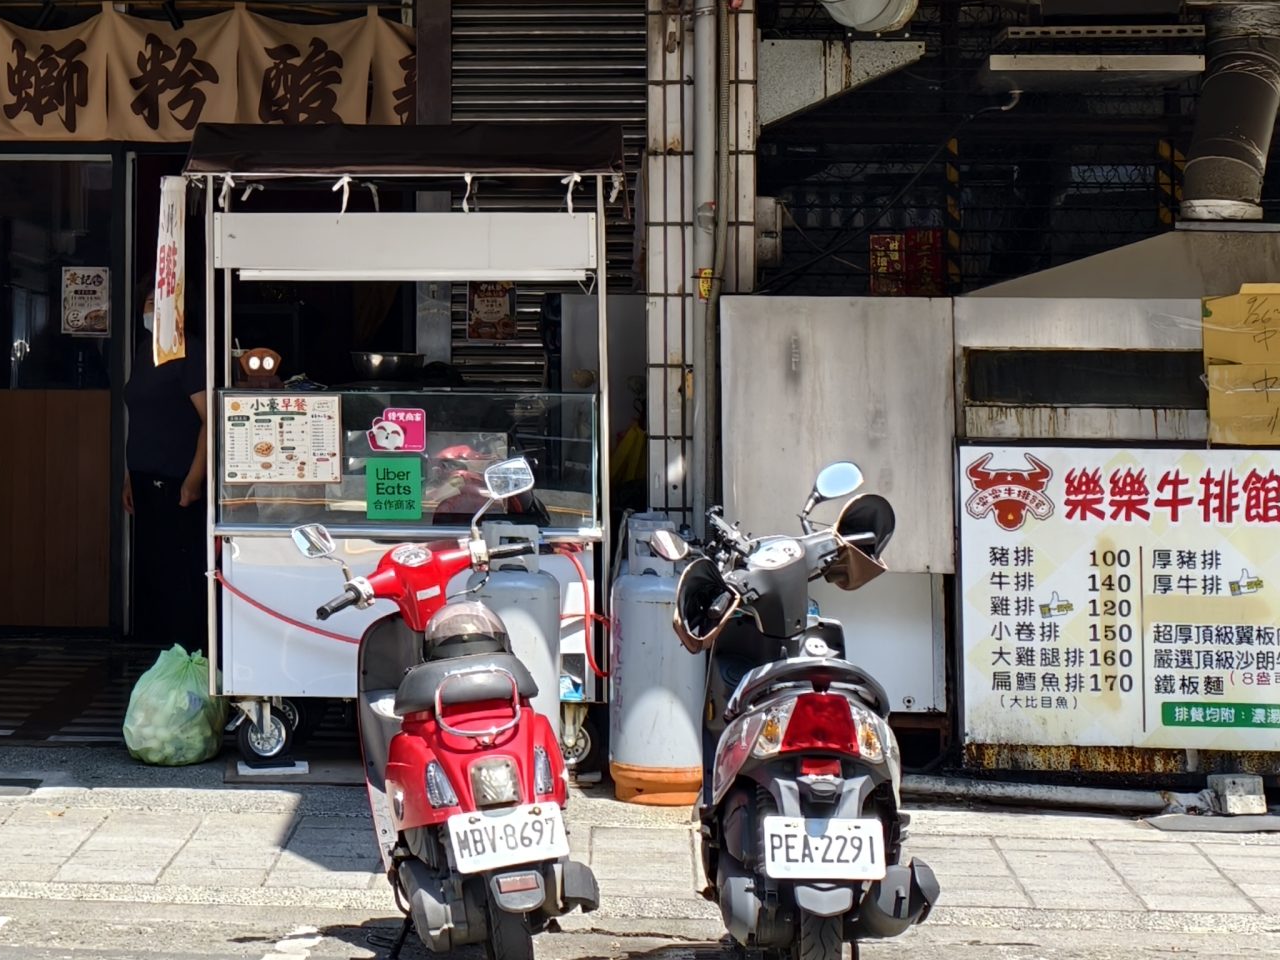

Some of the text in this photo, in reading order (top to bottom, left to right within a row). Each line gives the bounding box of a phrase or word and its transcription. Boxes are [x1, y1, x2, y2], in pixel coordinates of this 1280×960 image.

[375, 467, 411, 481] Uber
[375, 482, 412, 496] Eats
[1063, 466, 1280, 524] 樂樂牛排館
[373, 499, 416, 511] 合作商家
[989, 546, 1131, 568] 豬排 100
[1152, 549, 1222, 571] 厚豬排
[989, 571, 1132, 592] 牛排 140
[1152, 574, 1223, 595] 厚牛排
[990, 596, 1035, 617] 雞排
[1088, 599, 1132, 618] 120
[1088, 624, 1133, 642] 150
[1153, 625, 1280, 647] 超厚頂級翼板
[991, 646, 1133, 668] 大雞腿排 160
[1153, 650, 1280, 671] 嚴選頂級沙朗
[1089, 673, 1134, 692] 170
[455, 817, 557, 860] MBV-8697
[770, 831, 876, 865] PEA-2291
